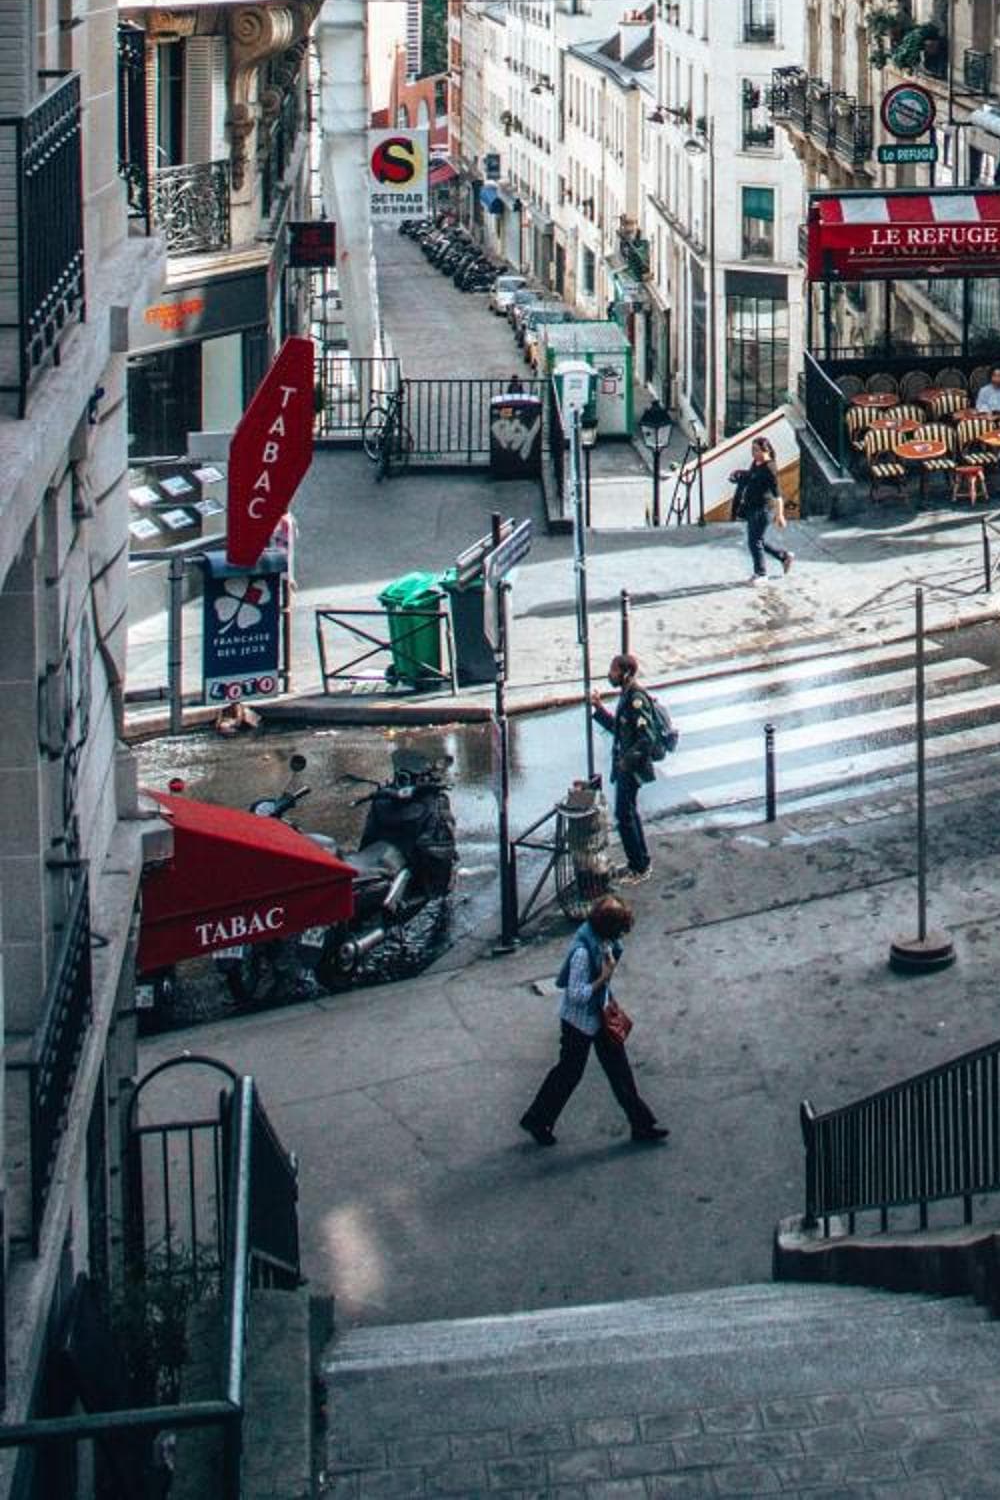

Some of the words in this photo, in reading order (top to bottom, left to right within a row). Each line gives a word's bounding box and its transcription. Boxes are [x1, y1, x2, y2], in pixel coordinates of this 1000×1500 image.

[897, 147, 935, 161] REFUGE
[871, 229, 901, 245] LE
[907, 227, 999, 245] REFUGE
[248, 386, 297, 520] TABAC
[217, 648, 237, 658] DES
[240, 645, 266, 657] JEUX
[210, 675, 276, 701] LOTO
[195, 906, 285, 946] TABAC
